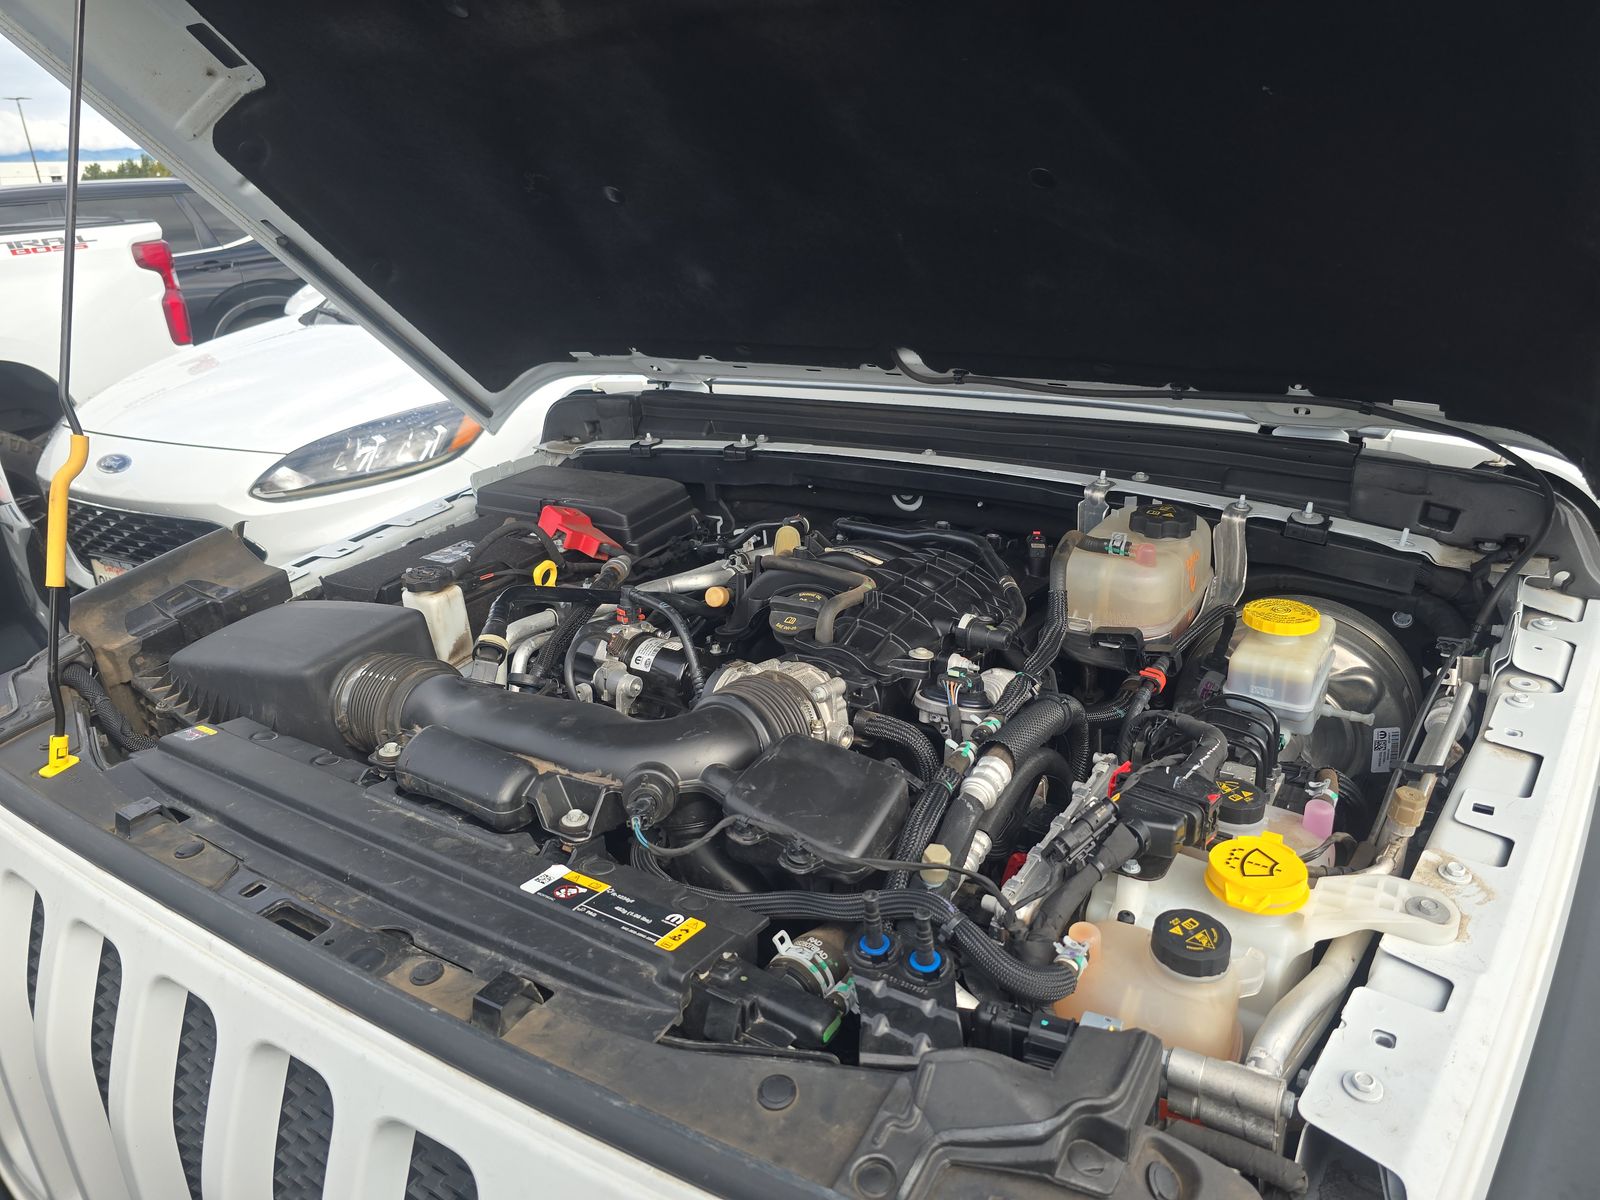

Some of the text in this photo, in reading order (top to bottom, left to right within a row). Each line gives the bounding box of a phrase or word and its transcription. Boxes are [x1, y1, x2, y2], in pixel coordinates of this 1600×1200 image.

[0, 235, 98, 249] TRAL
[10, 242, 89, 256] BOSS
[807, 936, 823, 947] RAD
